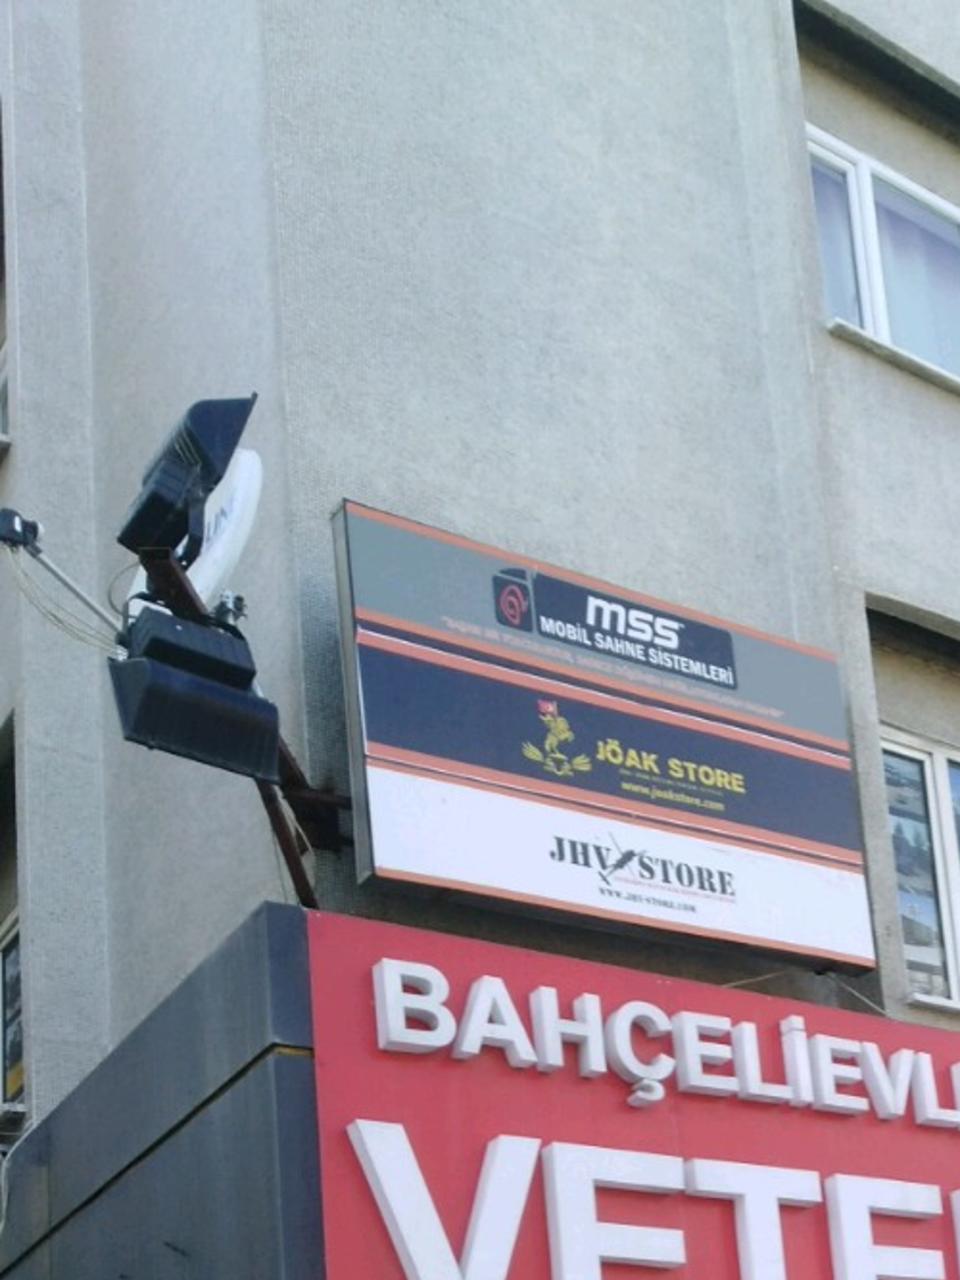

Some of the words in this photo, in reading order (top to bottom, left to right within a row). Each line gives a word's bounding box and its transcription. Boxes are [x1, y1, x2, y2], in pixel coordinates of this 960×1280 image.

[539, 615, 592, 646] MOBİL
[594, 632, 645, 662] SAHNE
[648, 645, 735, 685] SİSTEMLERİ
[667, 757, 746, 794] STORE
[549, 835, 611, 871] JHV
[637, 854, 736, 897] STORE
